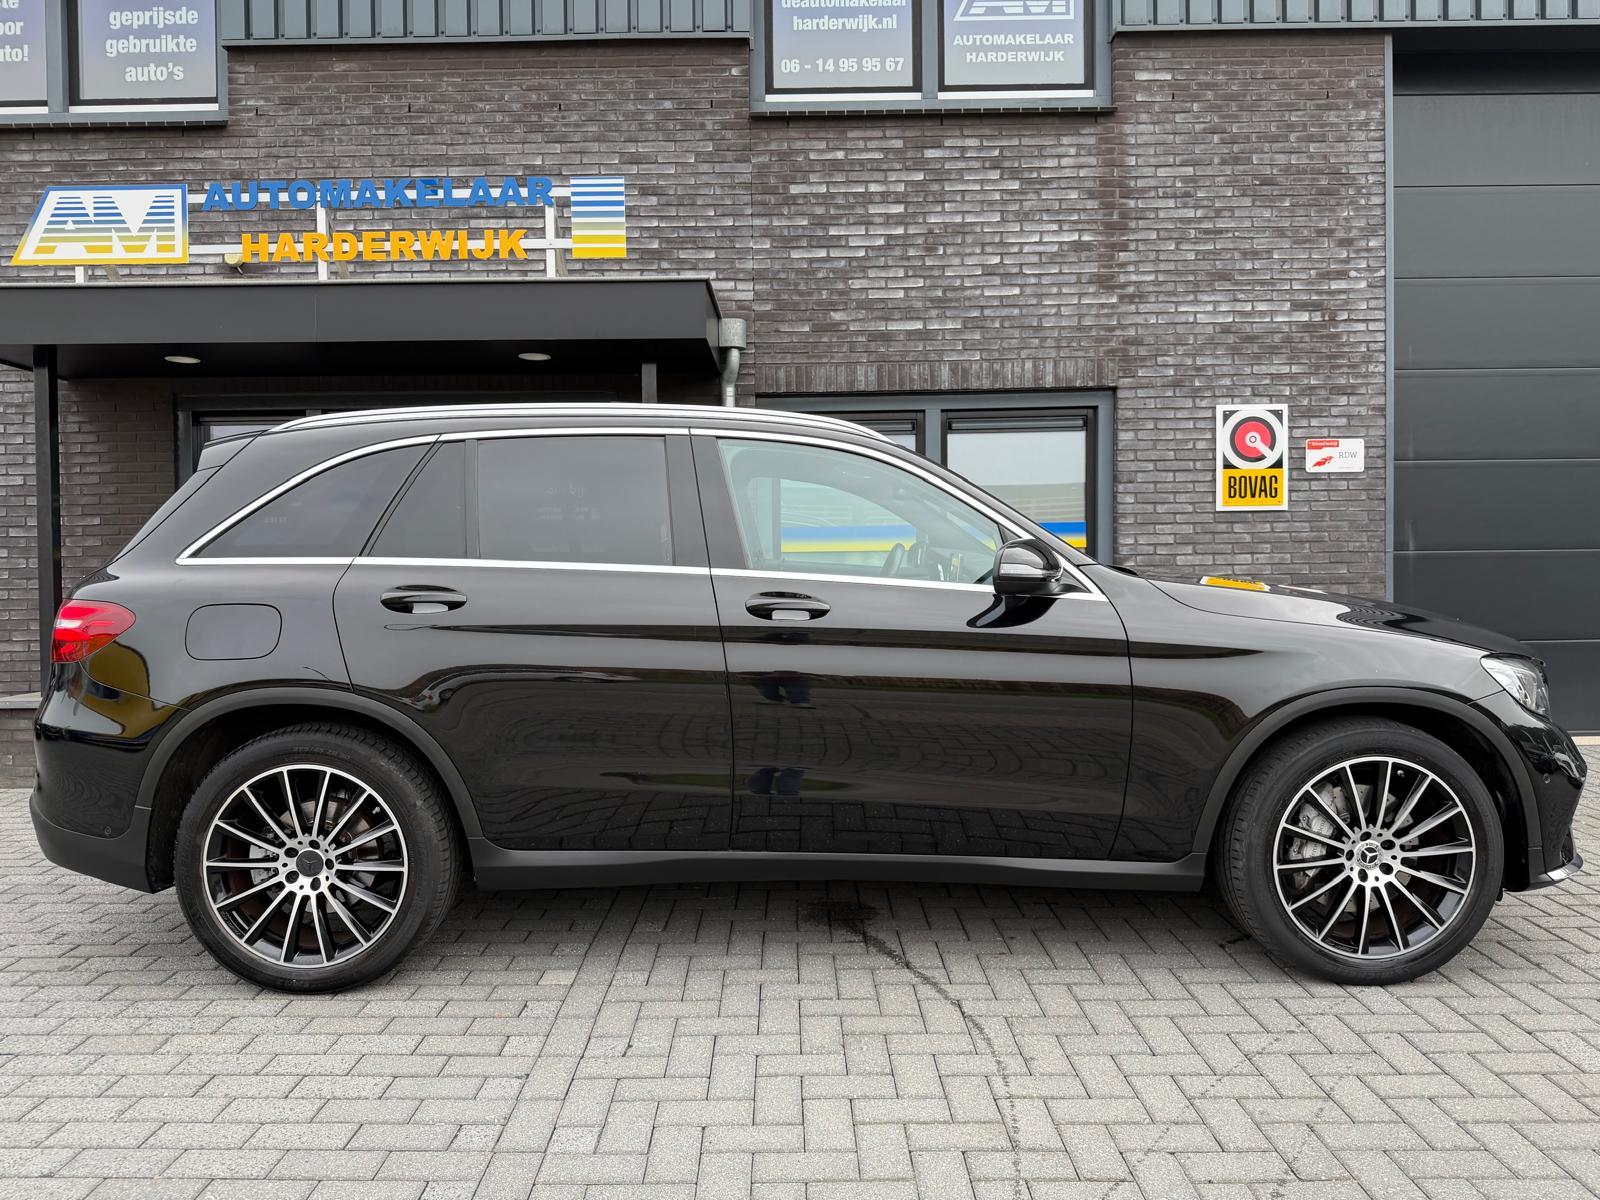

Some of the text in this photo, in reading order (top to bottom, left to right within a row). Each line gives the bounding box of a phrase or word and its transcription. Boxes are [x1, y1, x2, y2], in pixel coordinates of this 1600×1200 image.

[109, 6, 199, 29] geprijsde
[792, 15, 897, 32] harderwijk.nl
[105, 36, 197, 57] gebruikte
[953, 33, 1074, 46] AUTOMAKELAAR
[781, 59, 800, 73] 06
[815, 58, 835, 72] 14
[839, 58, 858, 72] 95
[862, 57, 881, 71] 95
[885, 57, 905, 71] 67
[966, 51, 1065, 63] HARDERWIJK
[203, 176, 554, 212] AUTOMAKELAAR
[241, 229, 529, 262] HARDERWIJK
[1338, 451, 1358, 459] RDW
[1228, 475, 1278, 498] BOVAG
